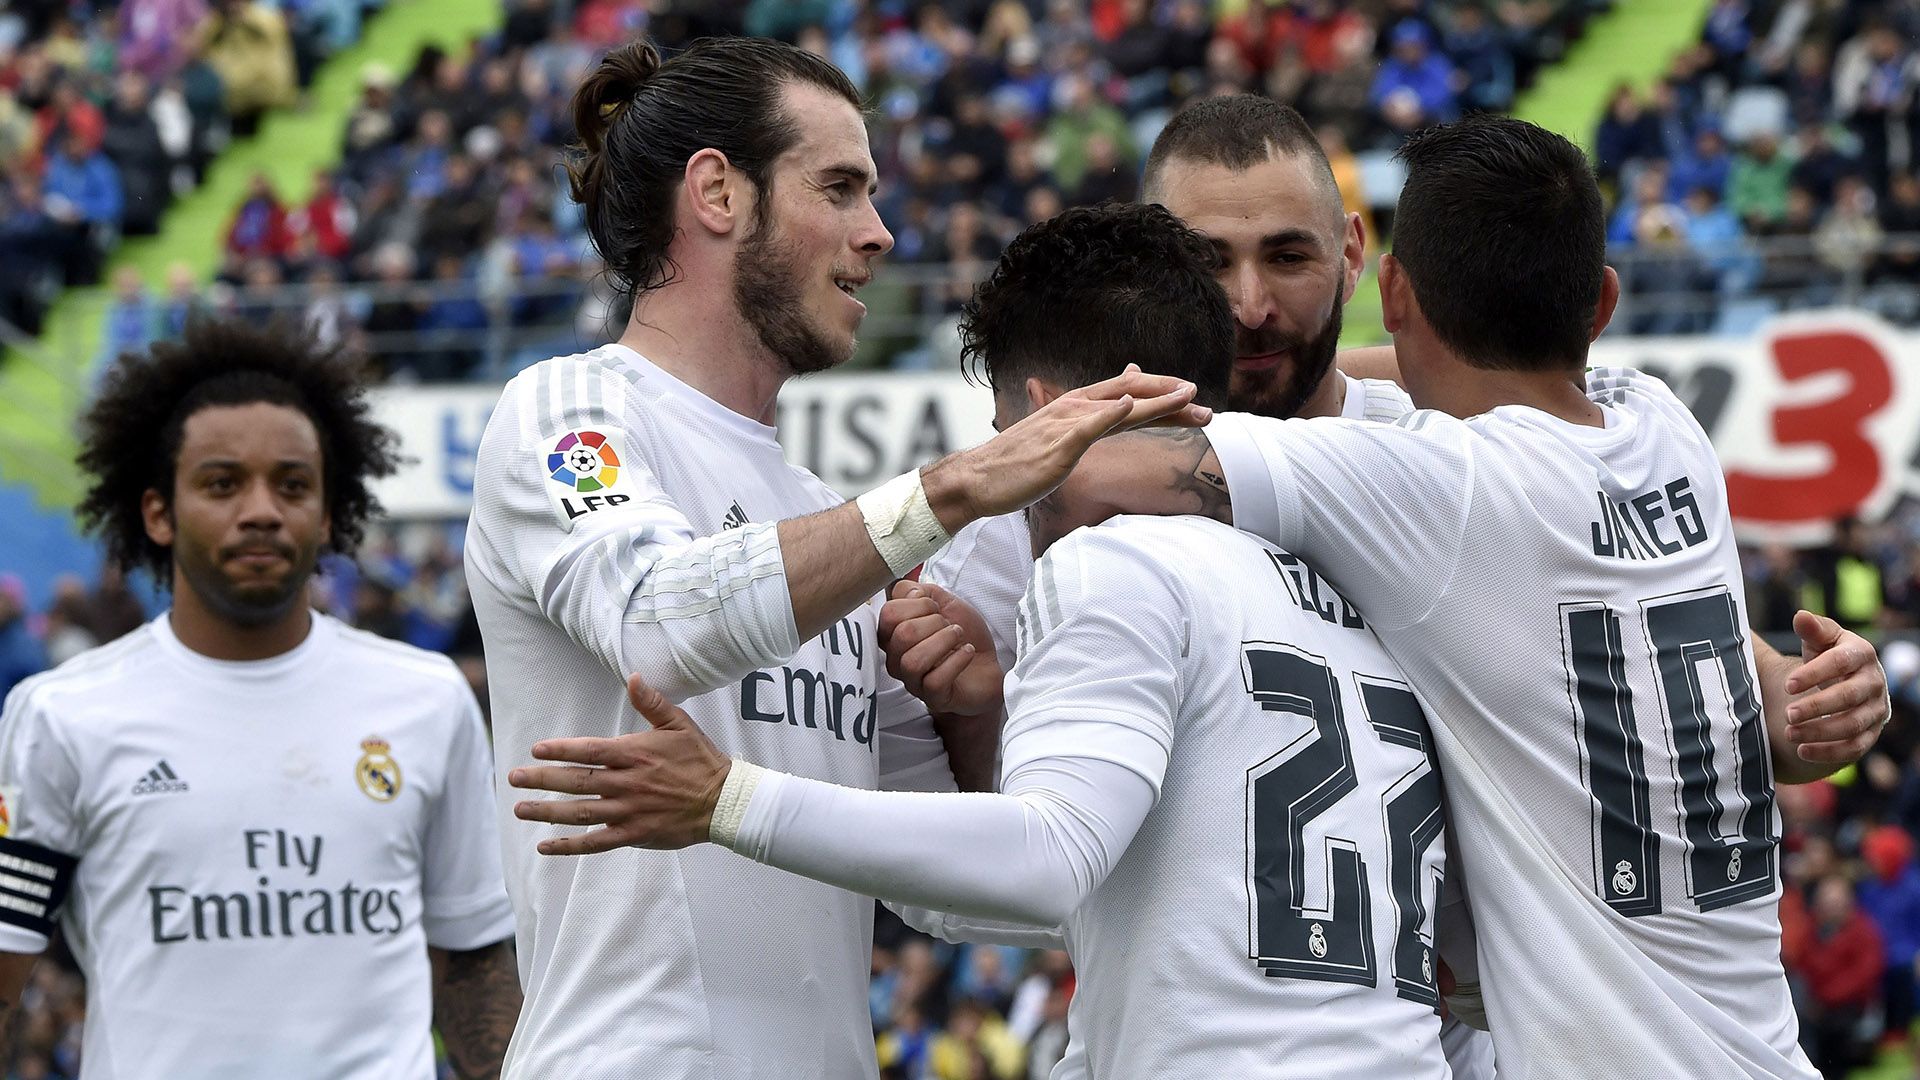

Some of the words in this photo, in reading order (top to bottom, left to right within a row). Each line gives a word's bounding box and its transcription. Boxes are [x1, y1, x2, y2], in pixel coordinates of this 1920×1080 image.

[776, 394, 954, 484] ISA
[560, 494, 631, 520] LFP
[820, 617, 864, 671] ly
[1557, 584, 1782, 918] 10
[244, 829, 323, 876] Fly
[1239, 640, 1447, 1016] 22
[147, 876, 402, 944] Emirates
